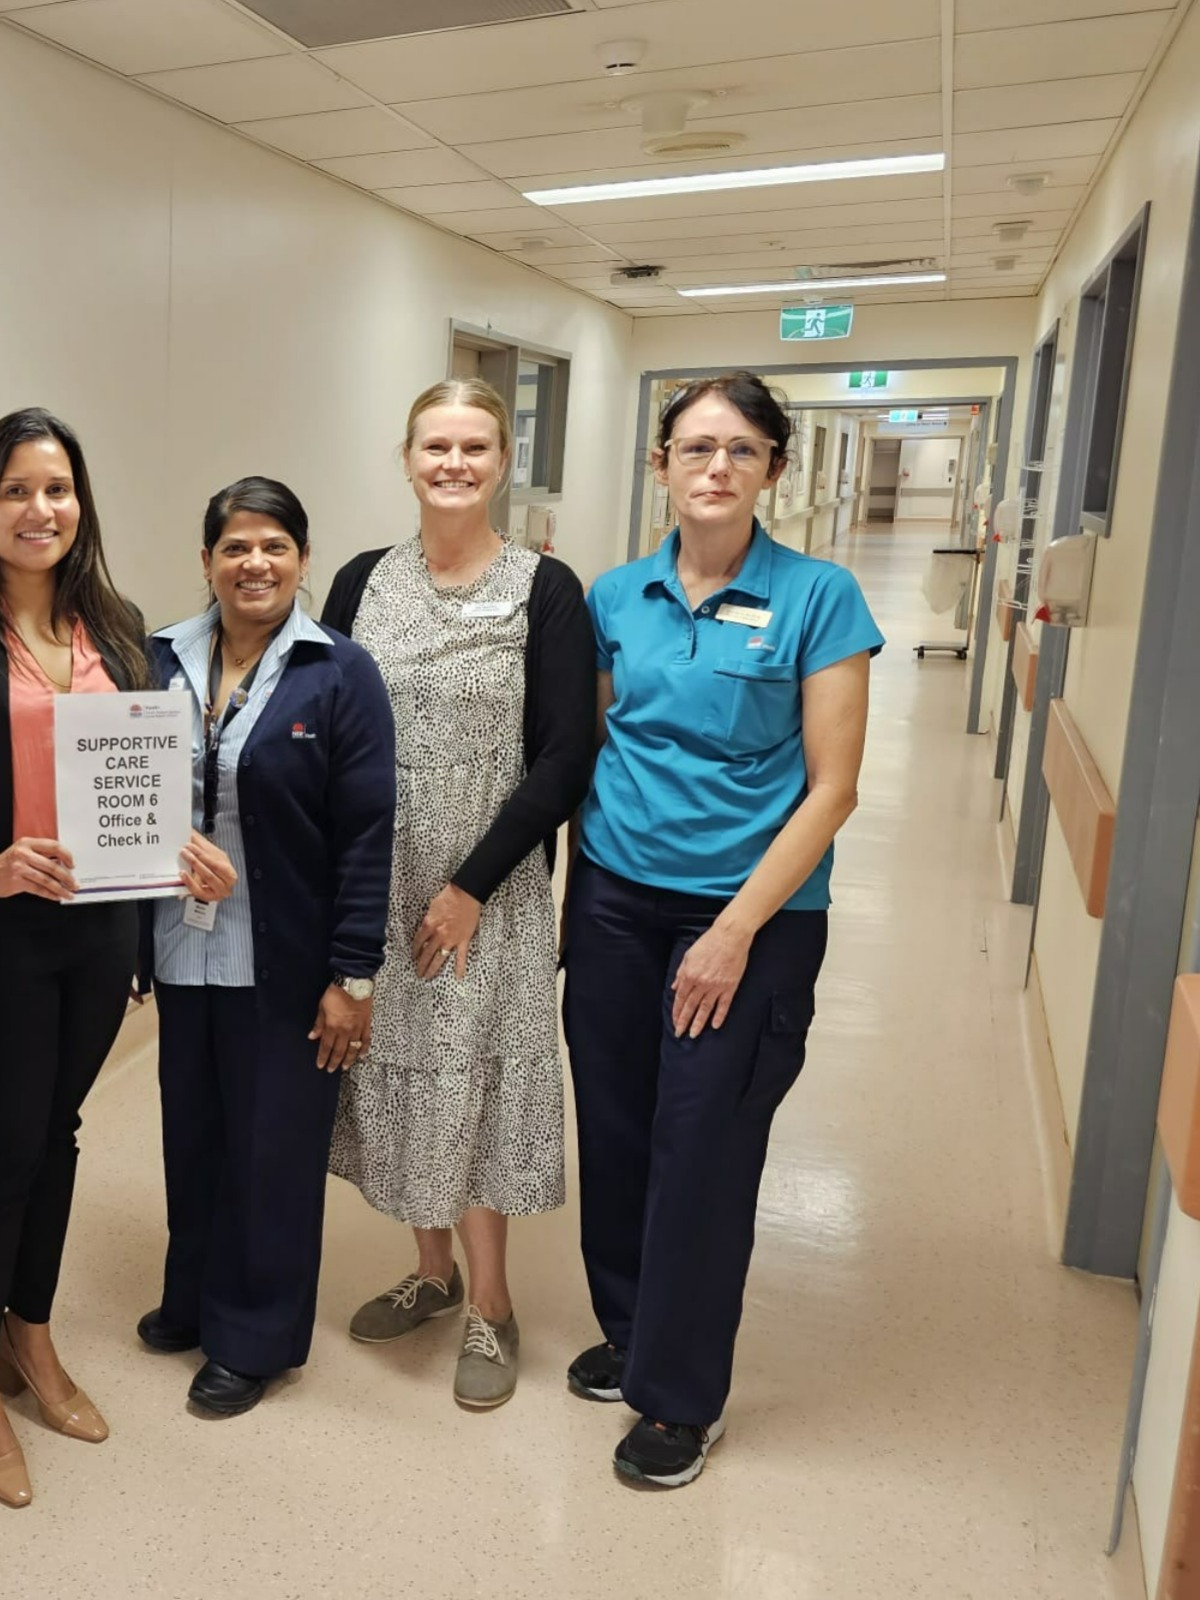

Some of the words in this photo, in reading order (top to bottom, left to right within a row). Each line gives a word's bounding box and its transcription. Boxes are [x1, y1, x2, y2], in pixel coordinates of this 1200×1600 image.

[76, 735, 179, 752] SUPPORTIVE
[105, 755, 150, 770] CARE
[93, 774, 162, 790] SERVICE
[97, 793, 145, 809] ROOM
[149, 793, 159, 807] 6
[98, 813, 143, 828] Office
[146, 812, 158, 826] &
[97, 832, 143, 848] Check
[146, 831, 160, 846] in
